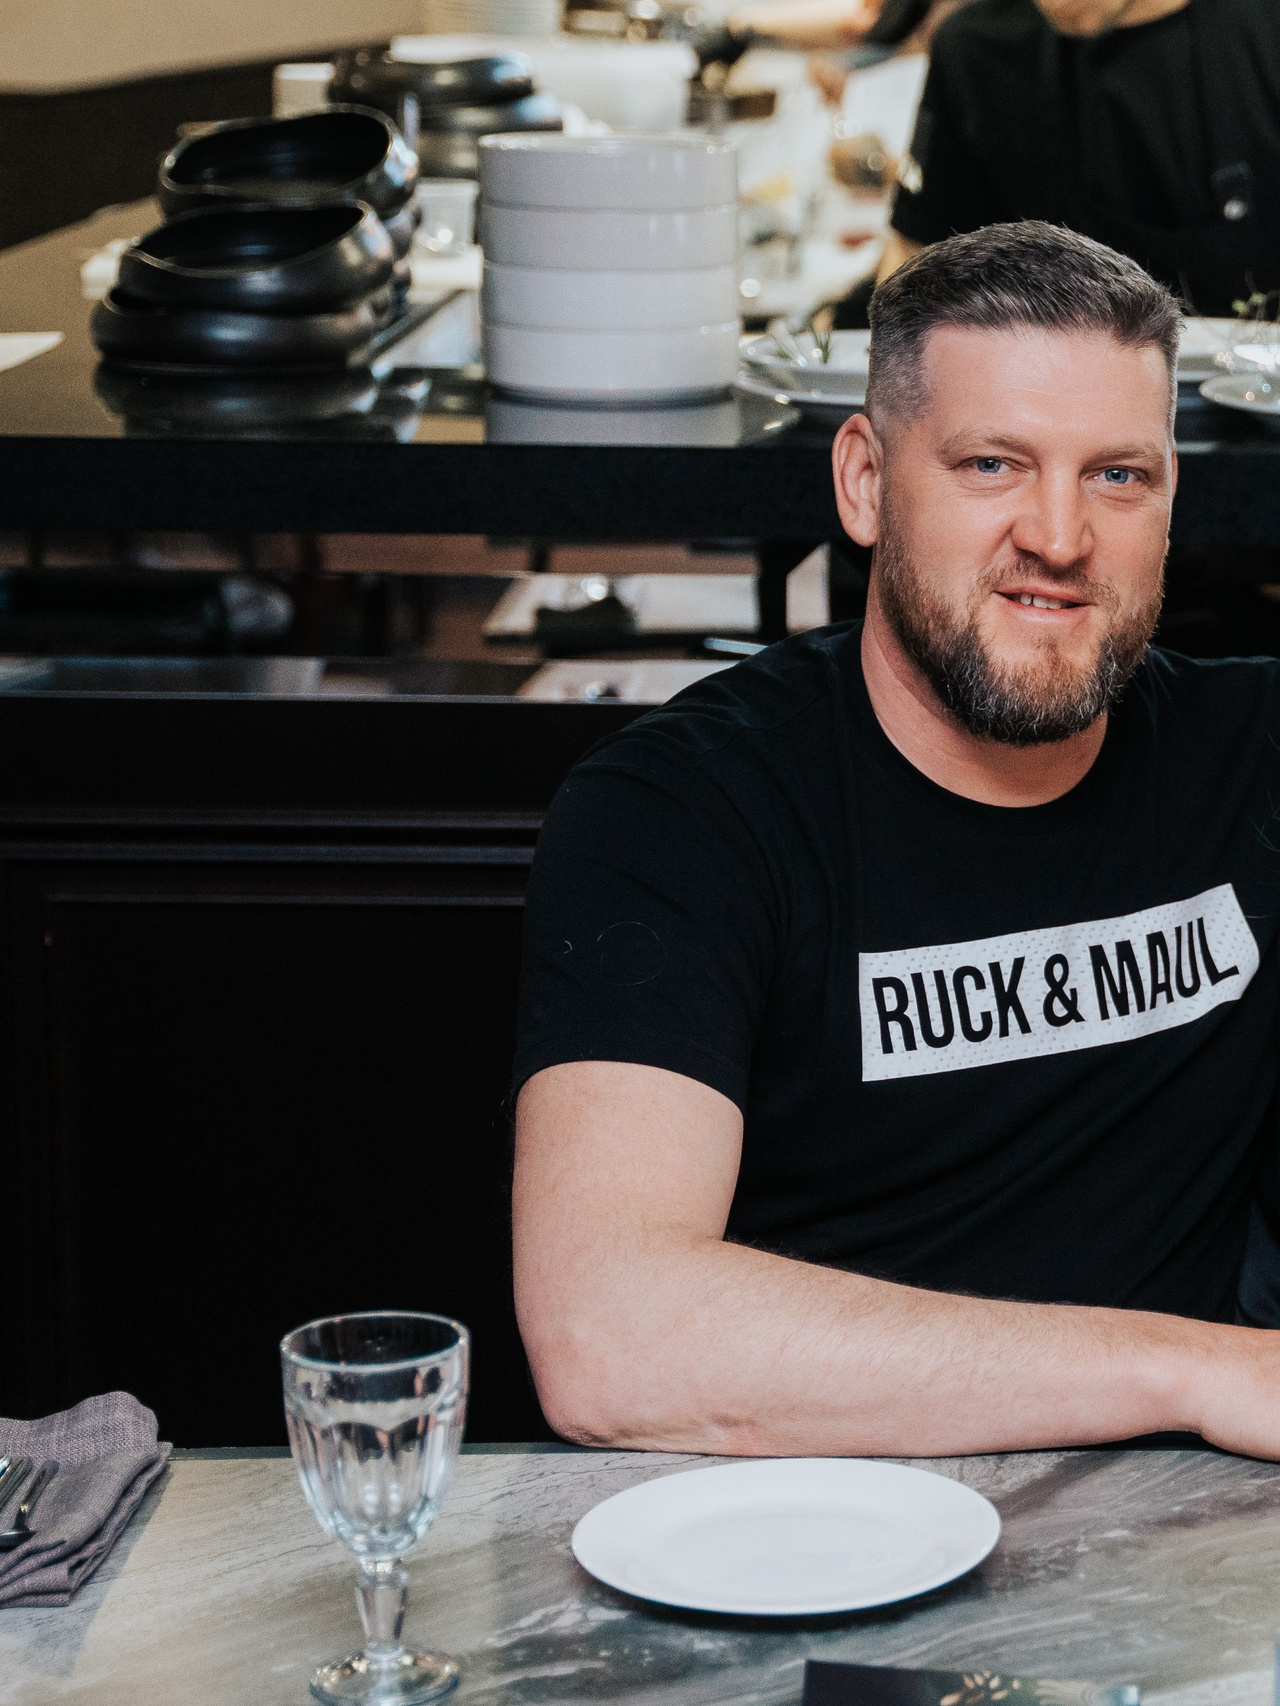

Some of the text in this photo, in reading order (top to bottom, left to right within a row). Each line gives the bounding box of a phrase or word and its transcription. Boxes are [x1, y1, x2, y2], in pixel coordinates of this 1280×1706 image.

[871, 916, 1240, 1055] RUCK & MAUL
